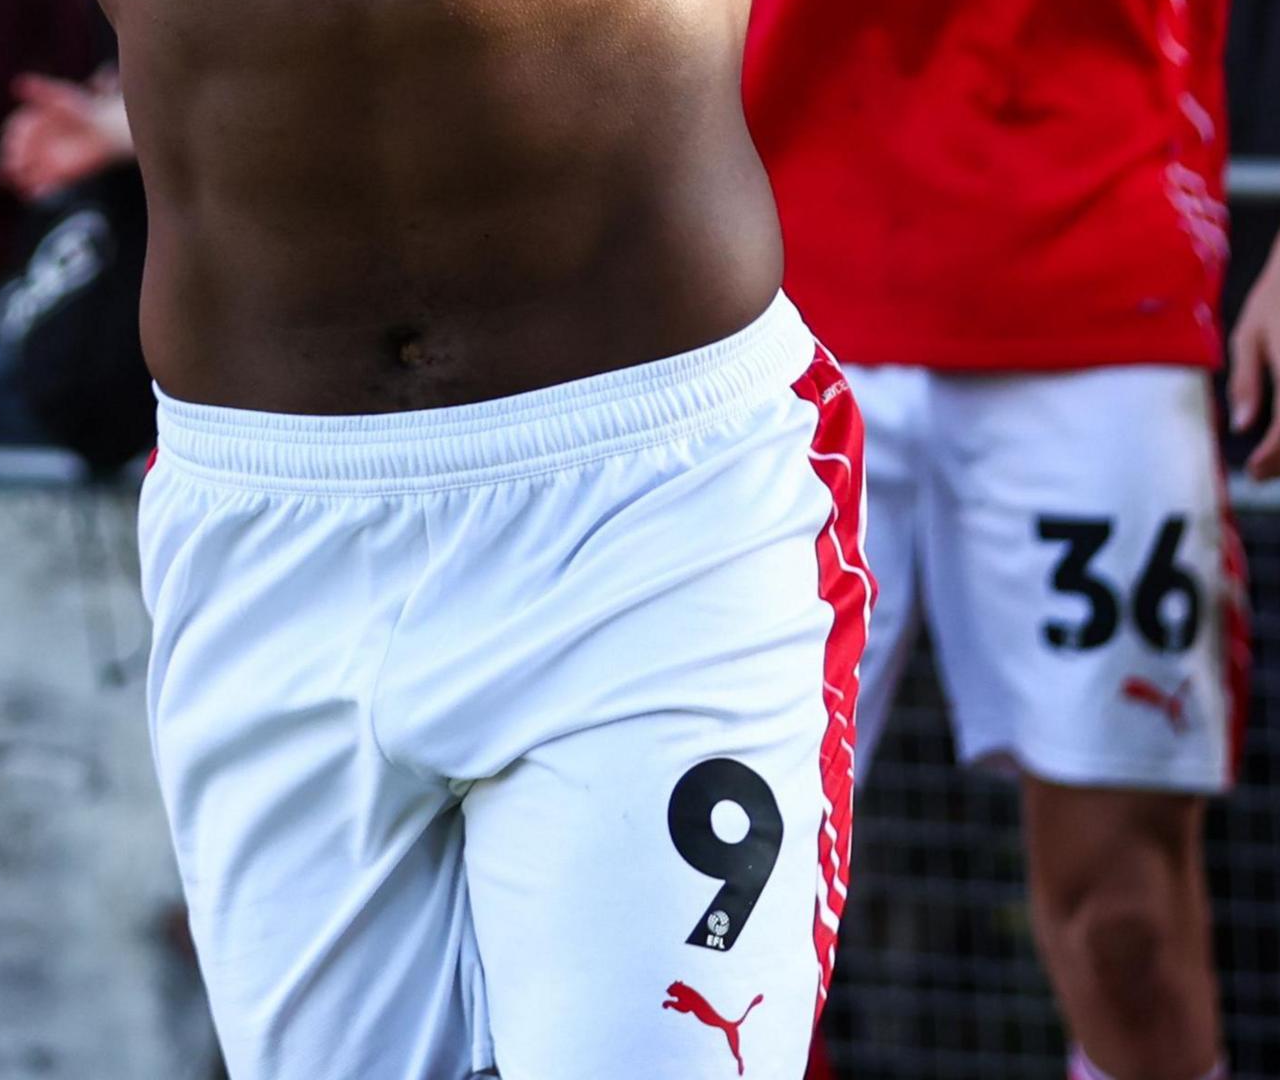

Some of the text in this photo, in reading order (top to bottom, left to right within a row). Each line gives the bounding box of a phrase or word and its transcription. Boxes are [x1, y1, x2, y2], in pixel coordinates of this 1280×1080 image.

[1034, 513, 1203, 654] 36
[667, 757, 784, 952] 9
[706, 934, 726, 950] EFL
